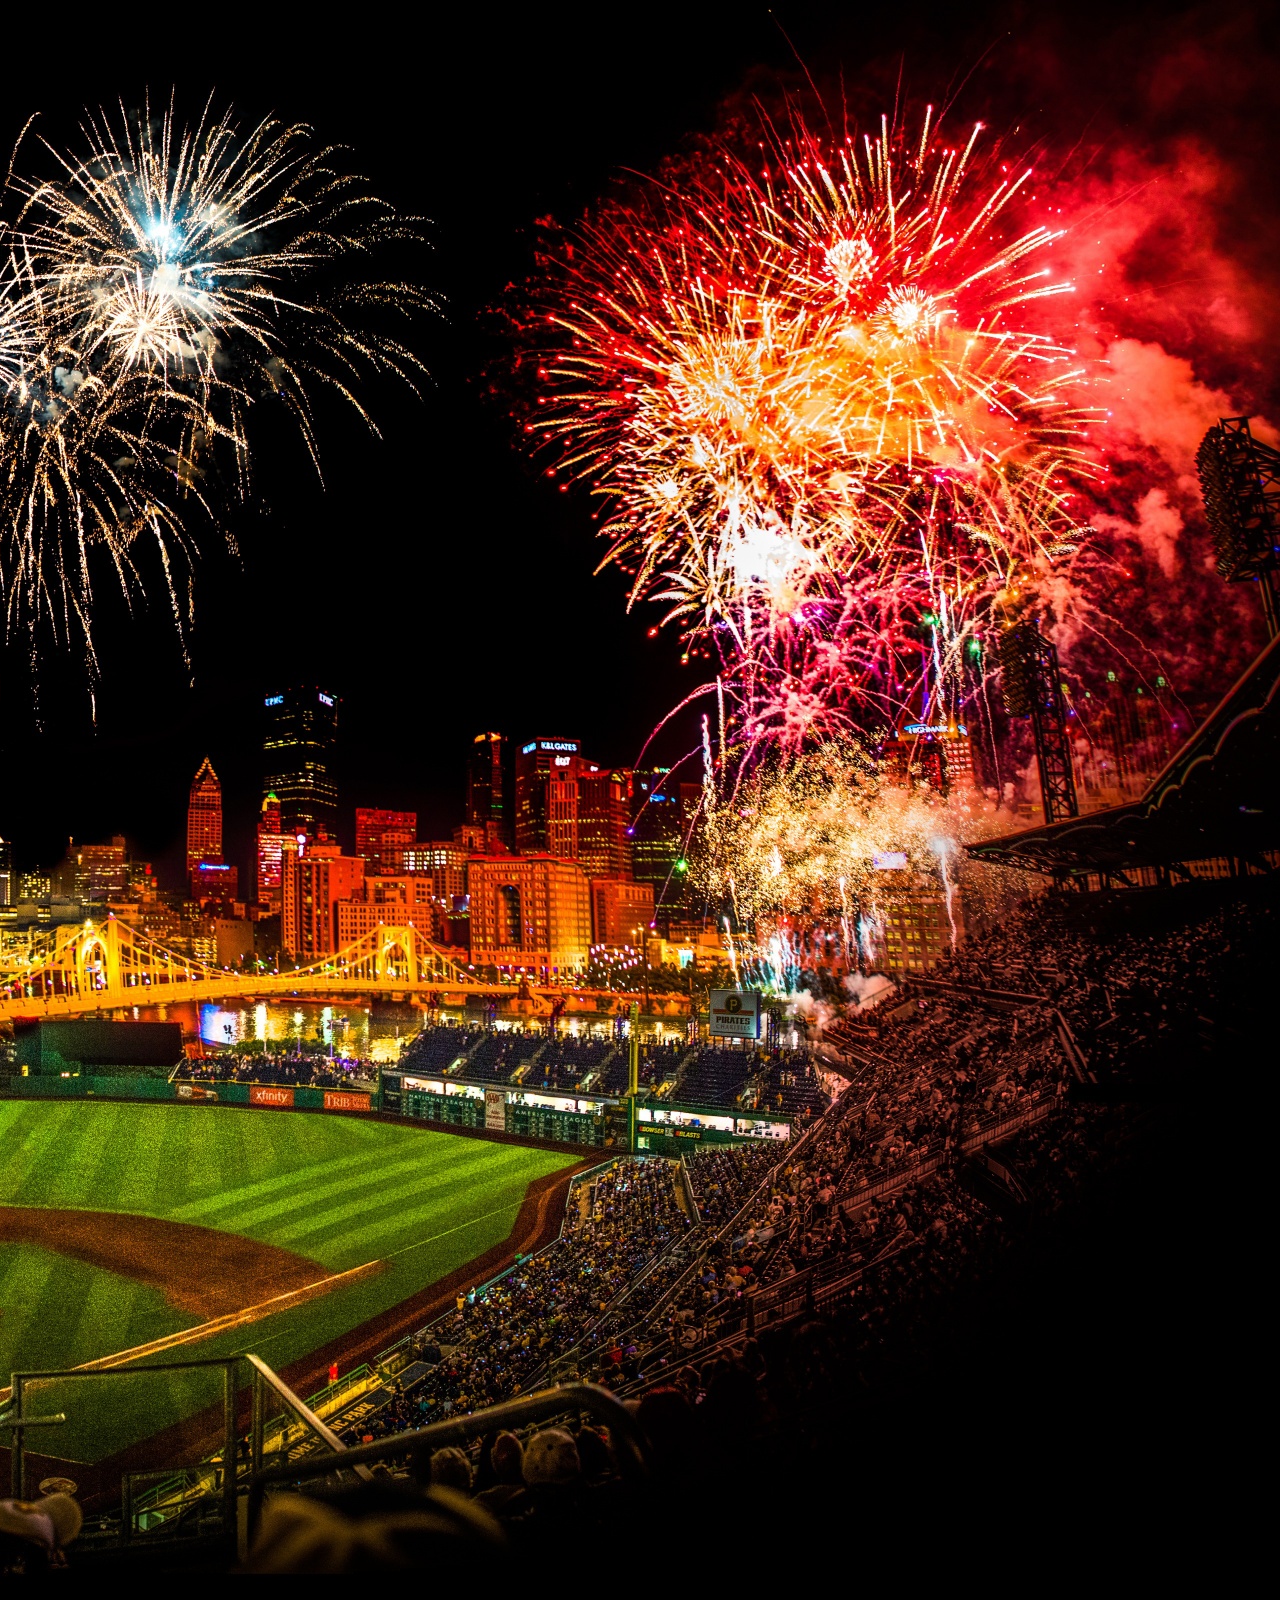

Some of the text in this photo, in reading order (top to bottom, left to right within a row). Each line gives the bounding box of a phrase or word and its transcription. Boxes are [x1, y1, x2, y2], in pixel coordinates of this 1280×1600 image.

[555, 743, 577, 751] GATES
[716, 1016, 751, 1025] PIRATES
[256, 1091, 288, 1103] xfinity
[325, 1095, 350, 1107] TRIB
[408, 1094, 443, 1104] NATIONAL
[445, 1099, 473, 1108] LEAGUE
[515, 1109, 557, 1120] AMERICAN
[559, 1115, 592, 1125] LEAGUE
[328, 1402, 376, 1432] NC PARK
